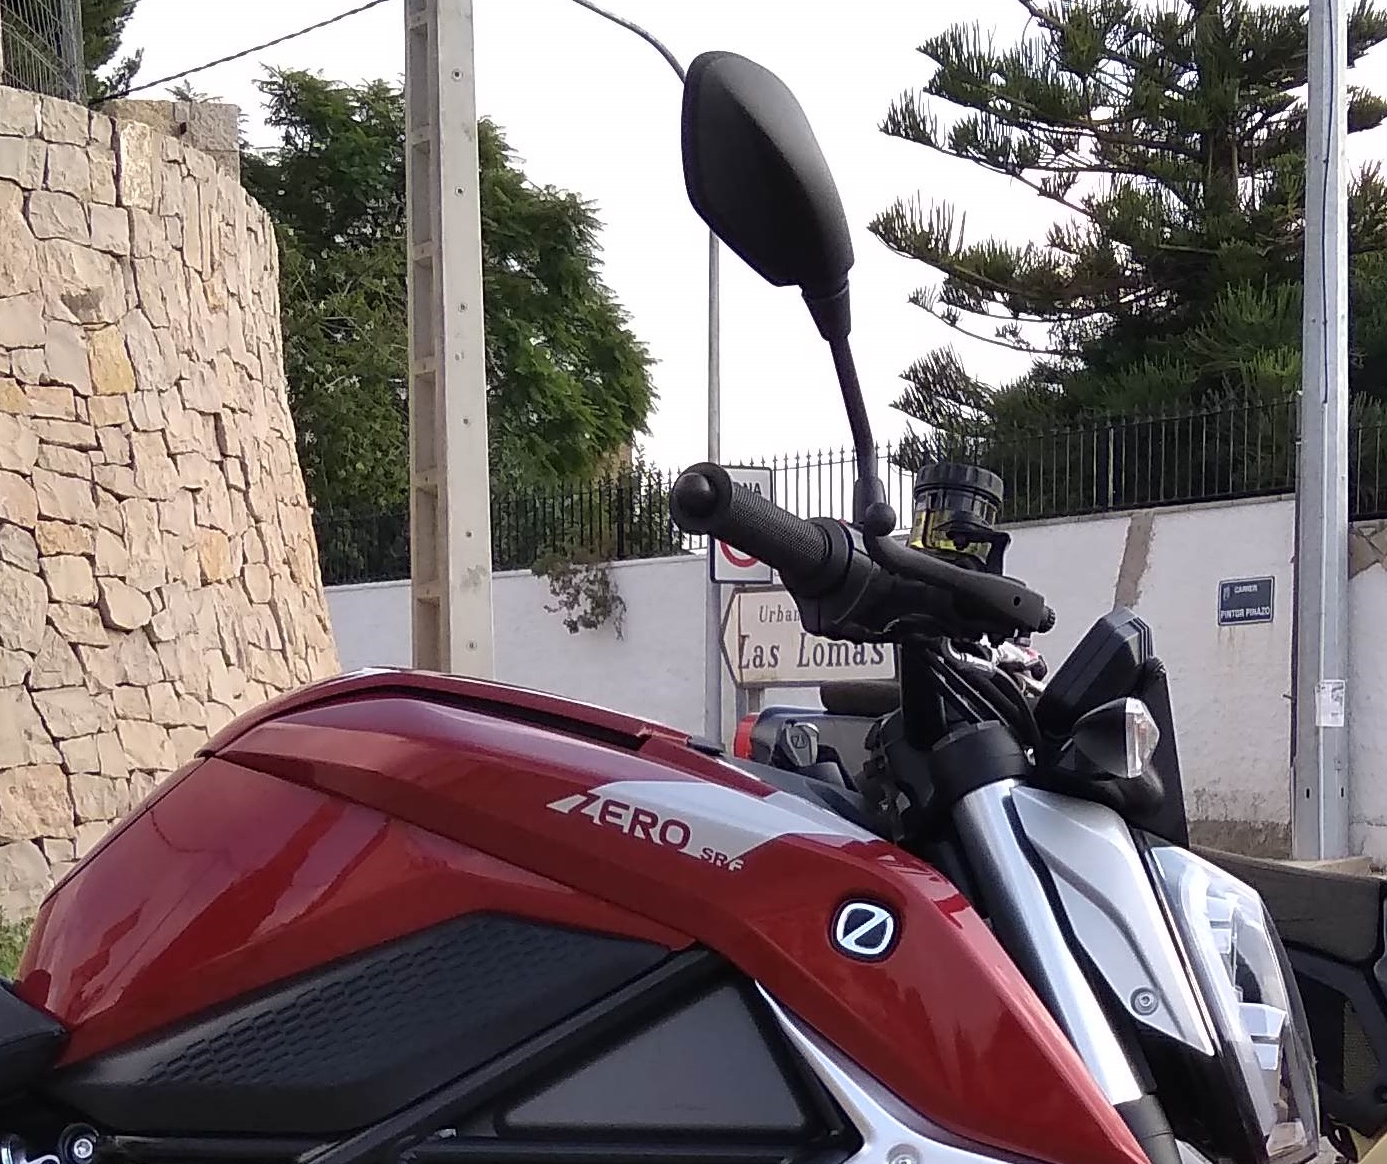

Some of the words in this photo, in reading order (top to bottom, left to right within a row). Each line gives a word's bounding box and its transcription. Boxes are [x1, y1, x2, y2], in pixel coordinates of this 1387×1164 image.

[737, 634, 780, 669] Las
[797, 632, 885, 668] Lomas
[548, 794, 691, 851] ZERO
